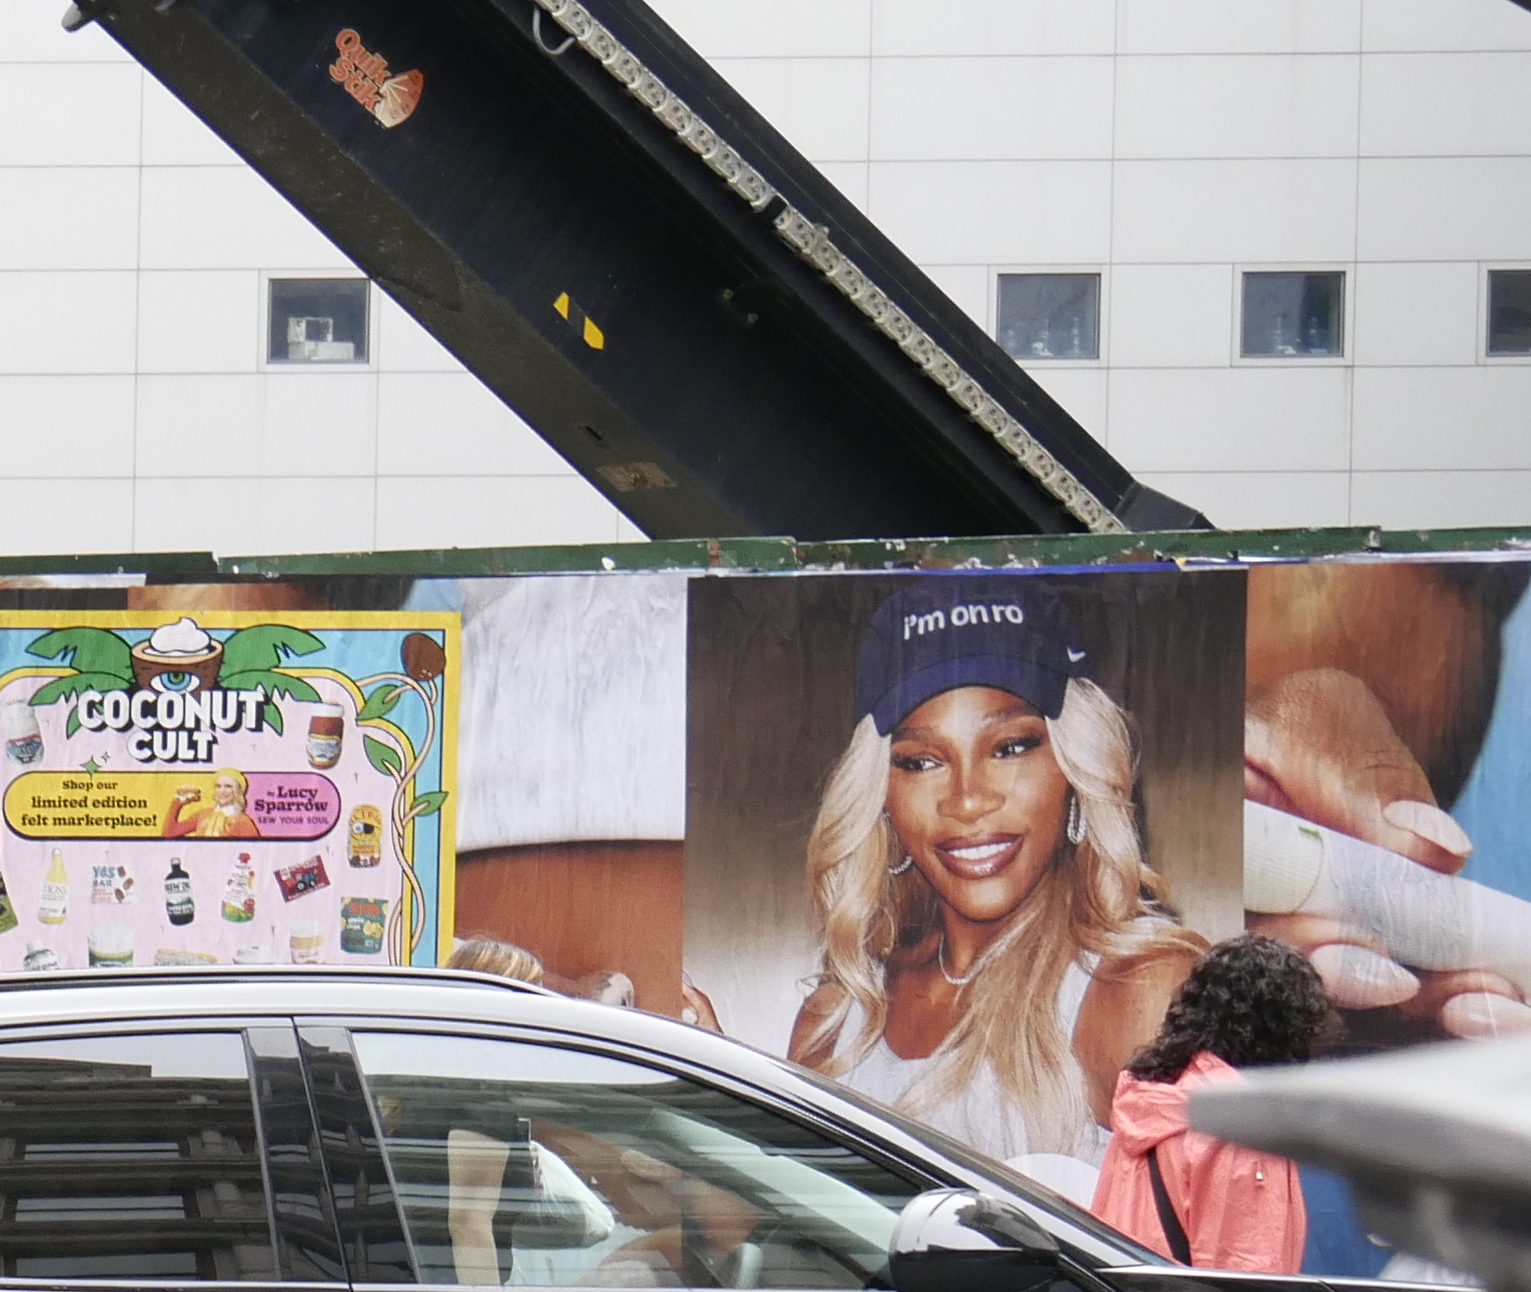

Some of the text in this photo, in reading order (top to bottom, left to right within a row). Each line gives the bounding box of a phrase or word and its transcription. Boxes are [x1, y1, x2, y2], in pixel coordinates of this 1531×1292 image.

[335, 28, 392, 88] Quik
[951, 604, 989, 626] on
[992, 604, 1024, 625] ro
[78, 689, 269, 731] COCONUT
[127, 730, 218, 763] CULT
[62, 779, 118, 792] Shop our
[278, 785, 318, 801] Lucy
[31, 796, 147, 809] limited edition
[254, 799, 328, 813] Sparrow
[21, 813, 158, 829] felt marketplace!
[307, 816, 329, 825] SOUL
